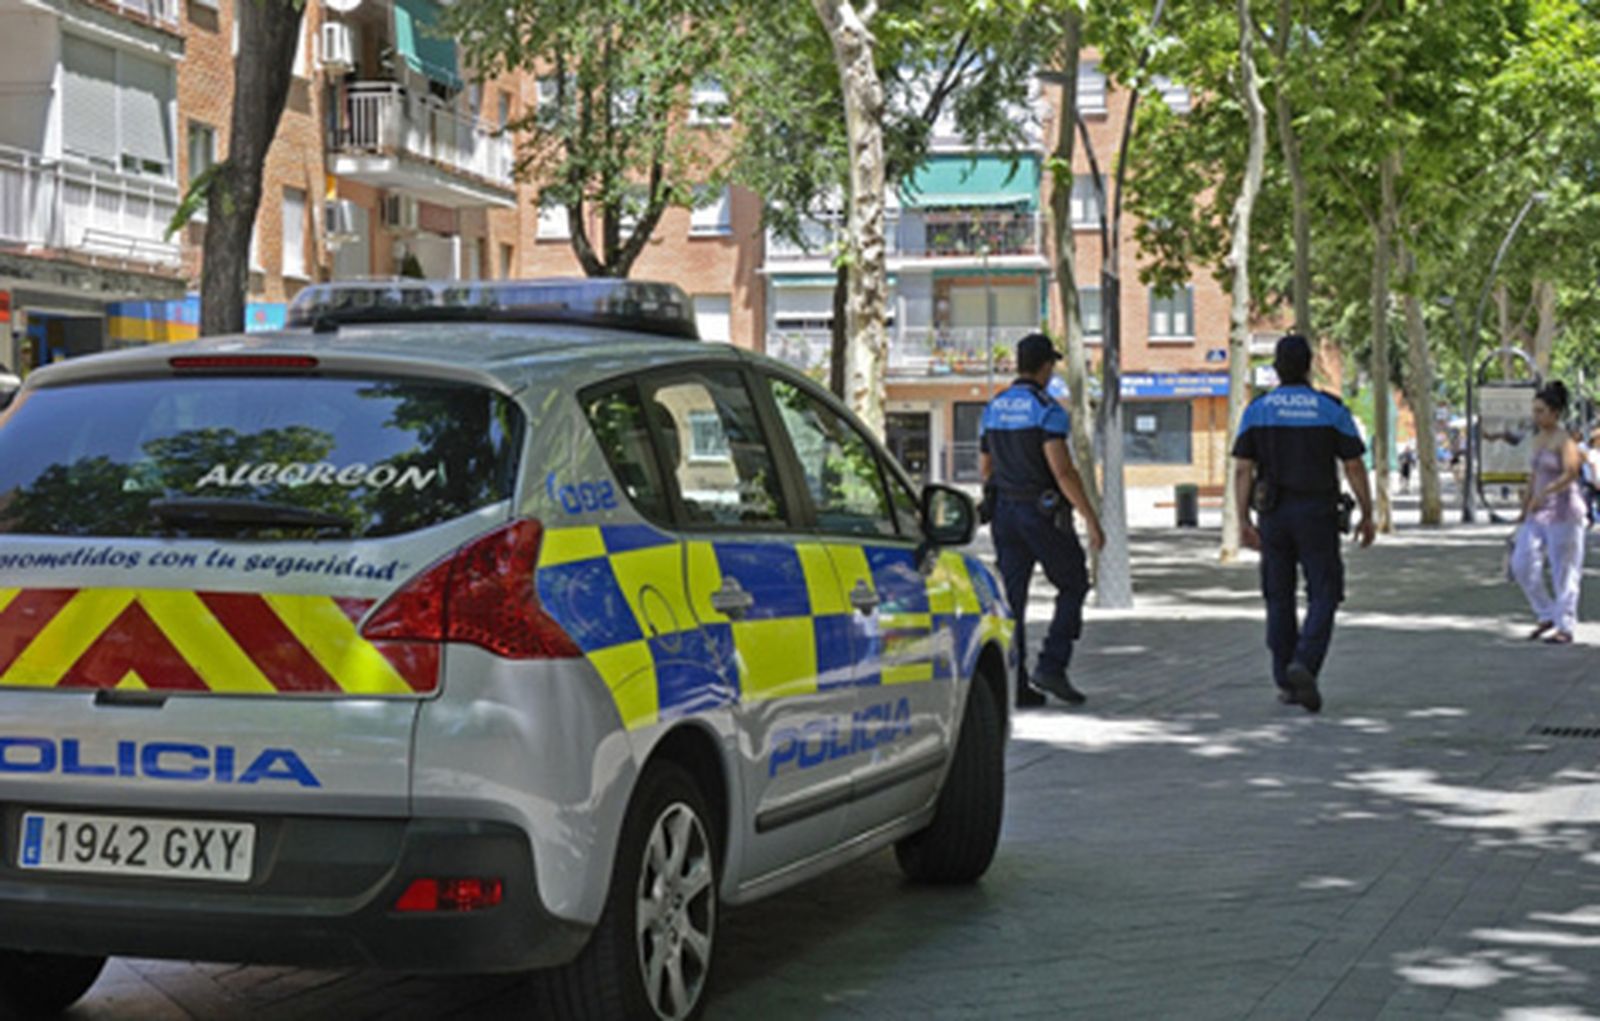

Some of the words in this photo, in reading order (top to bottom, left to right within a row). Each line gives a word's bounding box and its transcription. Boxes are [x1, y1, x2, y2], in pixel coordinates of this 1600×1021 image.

[148, 552, 198, 568] con
[205, 549, 237, 569] tu
[0, 737, 322, 787] OLICIA
[769, 697, 912, 778] POLICIA
[56, 822, 149, 867] 1942
[163, 827, 243, 871] GXY
